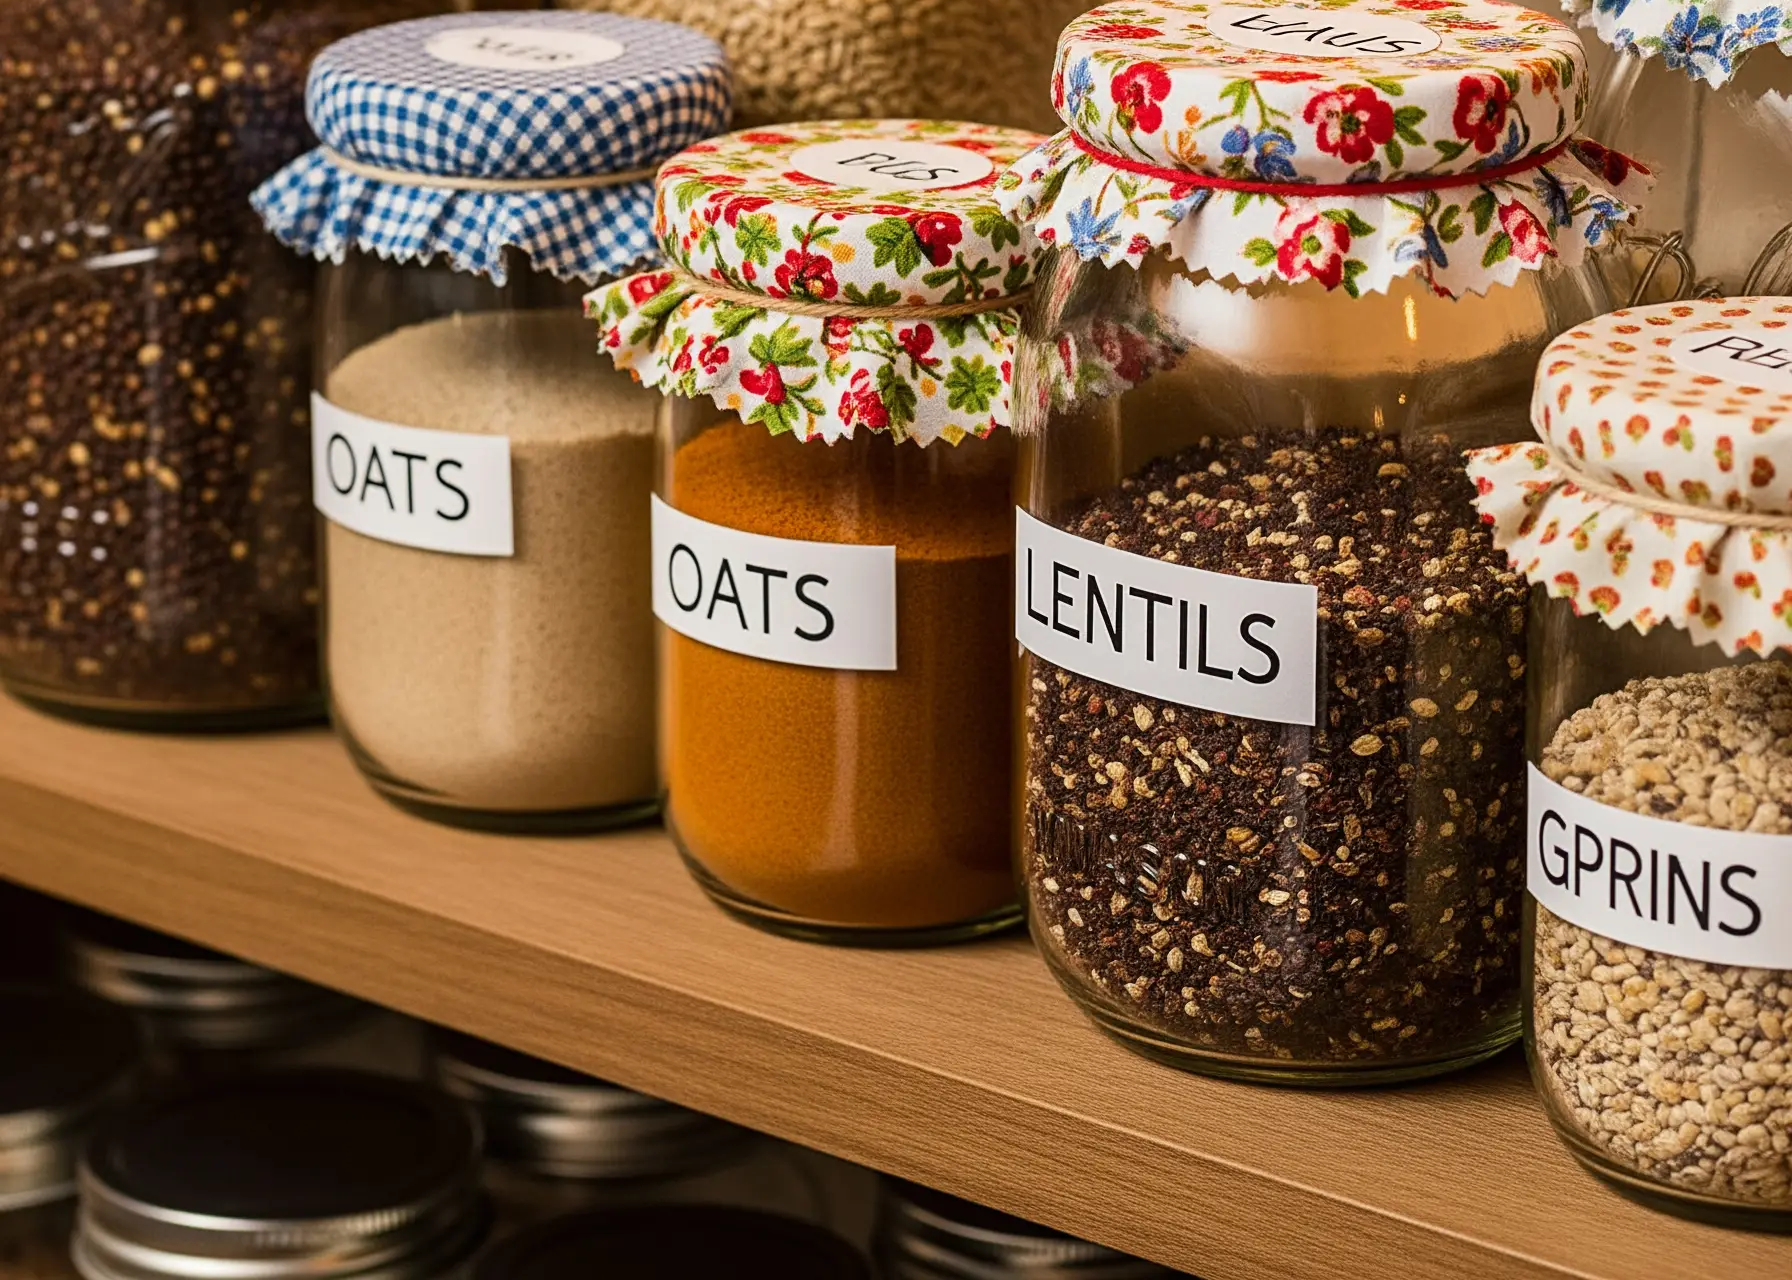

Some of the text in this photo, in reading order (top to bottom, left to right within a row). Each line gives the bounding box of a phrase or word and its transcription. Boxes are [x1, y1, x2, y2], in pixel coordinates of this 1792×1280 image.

[326, 433, 470, 521] OATS
[668, 543, 835, 642] OATS
[1027, 548, 1281, 685] LENTILS
[1538, 809, 1762, 937] GPRINS
